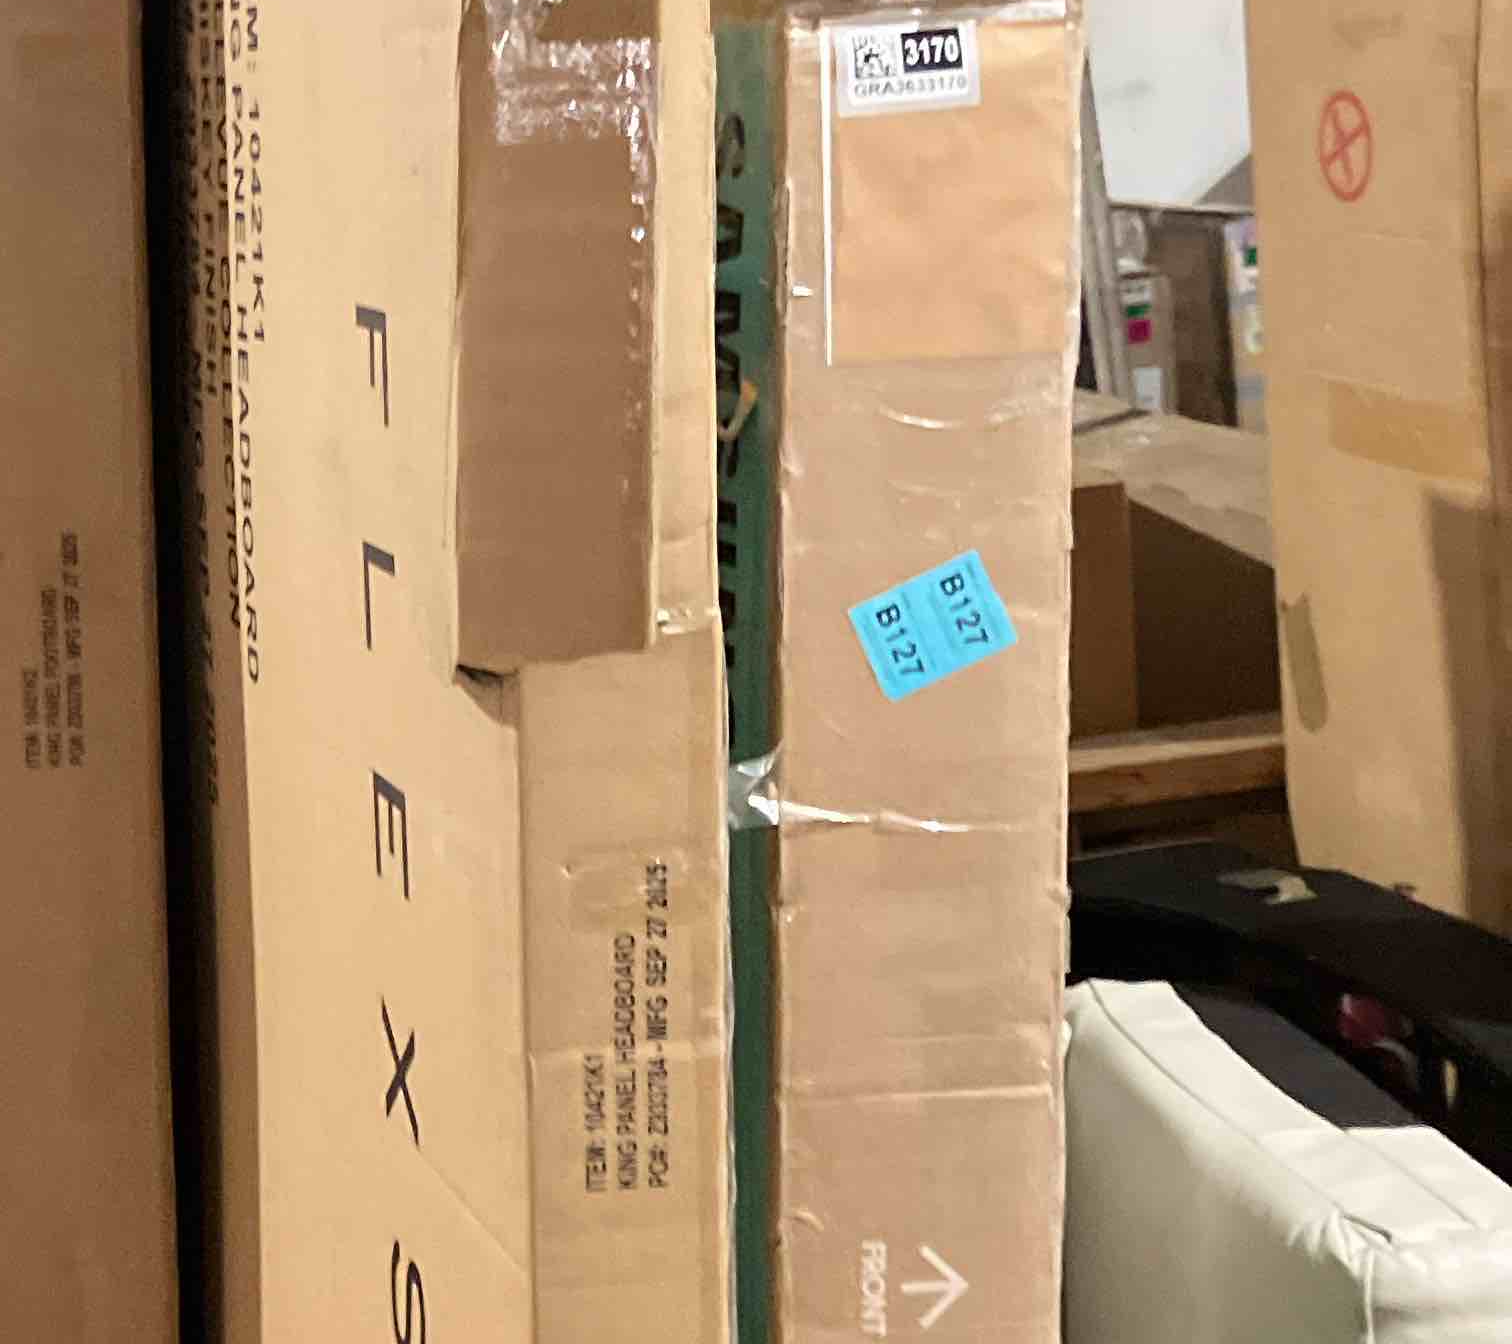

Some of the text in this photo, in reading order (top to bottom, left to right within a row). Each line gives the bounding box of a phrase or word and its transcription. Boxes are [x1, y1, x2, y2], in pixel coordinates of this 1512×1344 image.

[904, 35, 960, 66] 3170
[231, 86, 248, 281] PANEL
[248, 100, 265, 343] 10421K1
[202, 213, 218, 398] FINISH
[219, 256, 241, 628] COLLECTION
[236, 305, 260, 684] HEADBOARD
[875, 602, 925, 676] B127
[940, 573, 989, 645] B127
[646, 918, 667, 939] 27
[646, 946, 667, 987] SEP
[646, 996, 668, 1040] MFG
[613, 934, 637, 1190] KING PANEL HEADBOARD
[585, 1137, 606, 1193] ITEM:
[860, 1240, 888, 1337] FRONT
